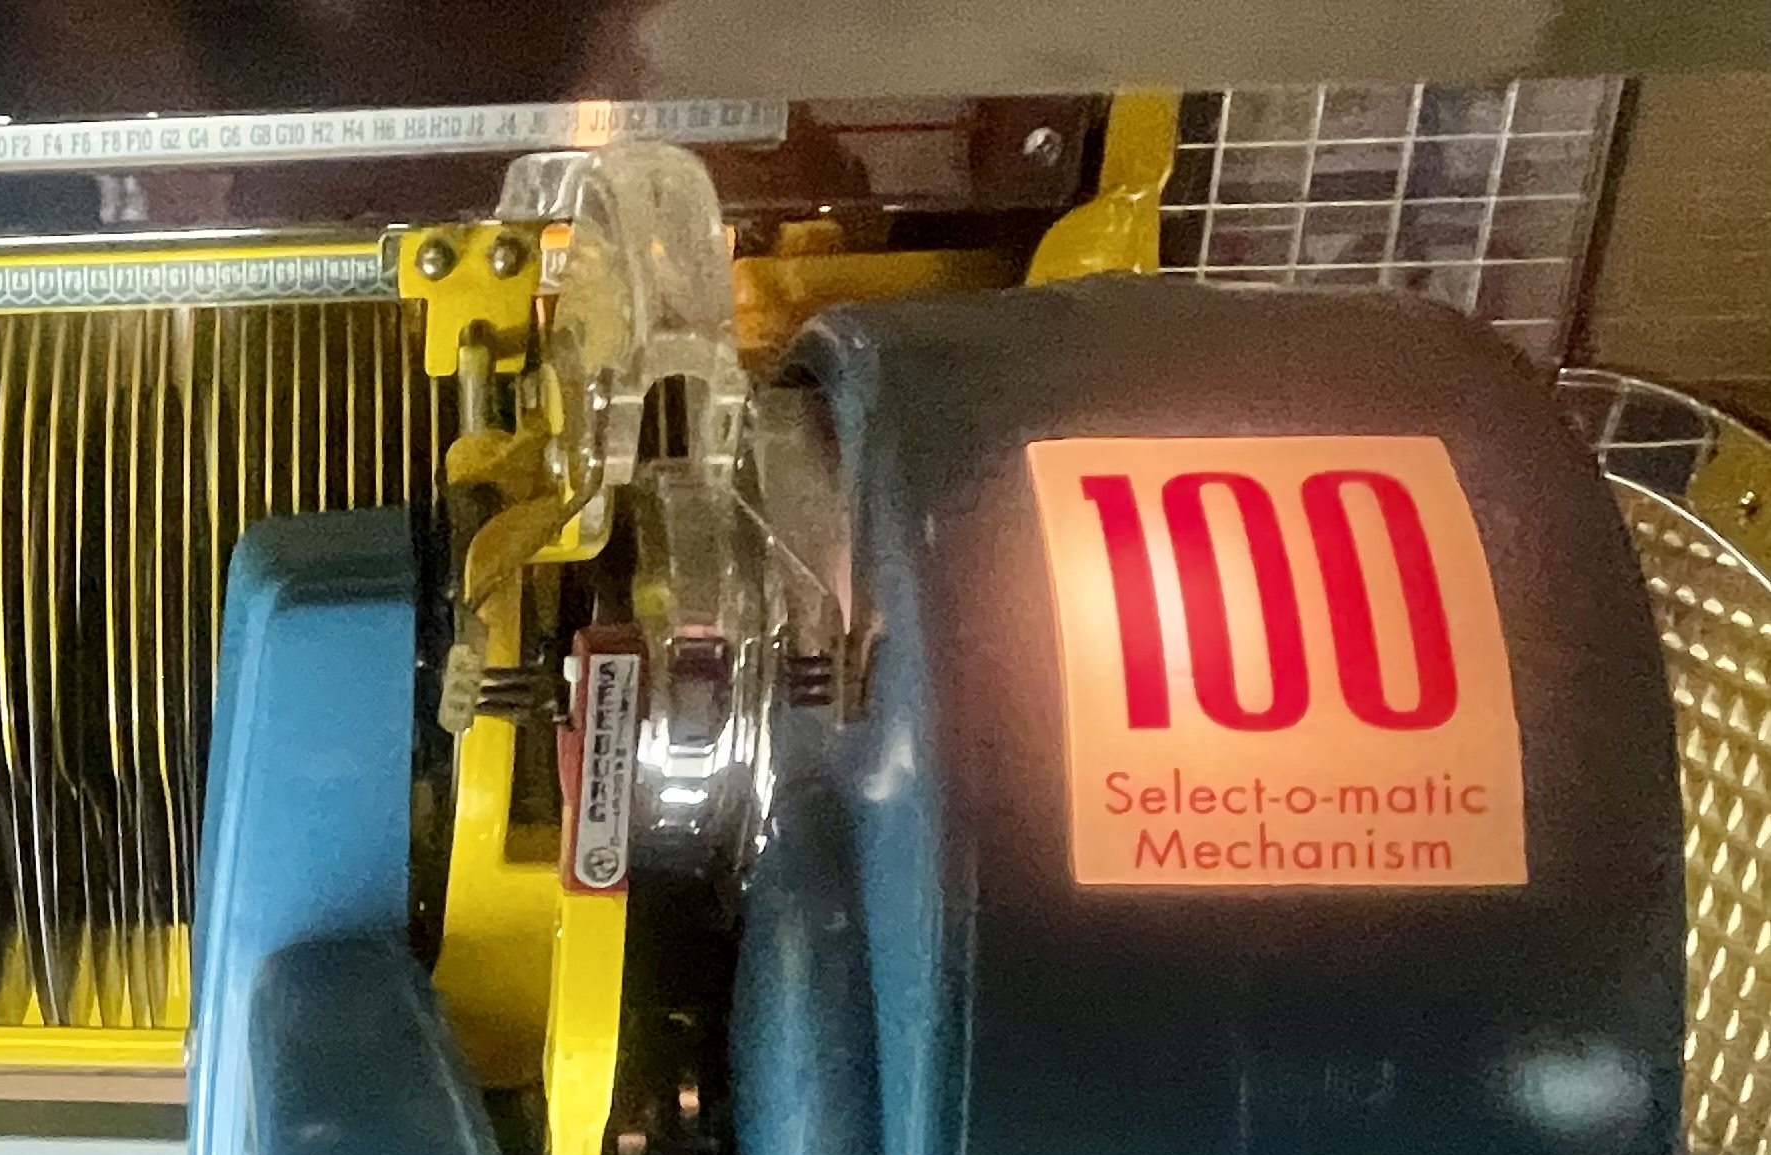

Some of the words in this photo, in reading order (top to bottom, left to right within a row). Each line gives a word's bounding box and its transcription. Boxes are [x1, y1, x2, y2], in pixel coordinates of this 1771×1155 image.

[1081, 470, 1458, 732] 100
[1105, 769, 1489, 817] Select-o-matic
[1136, 823, 1452, 870] Mechanism
